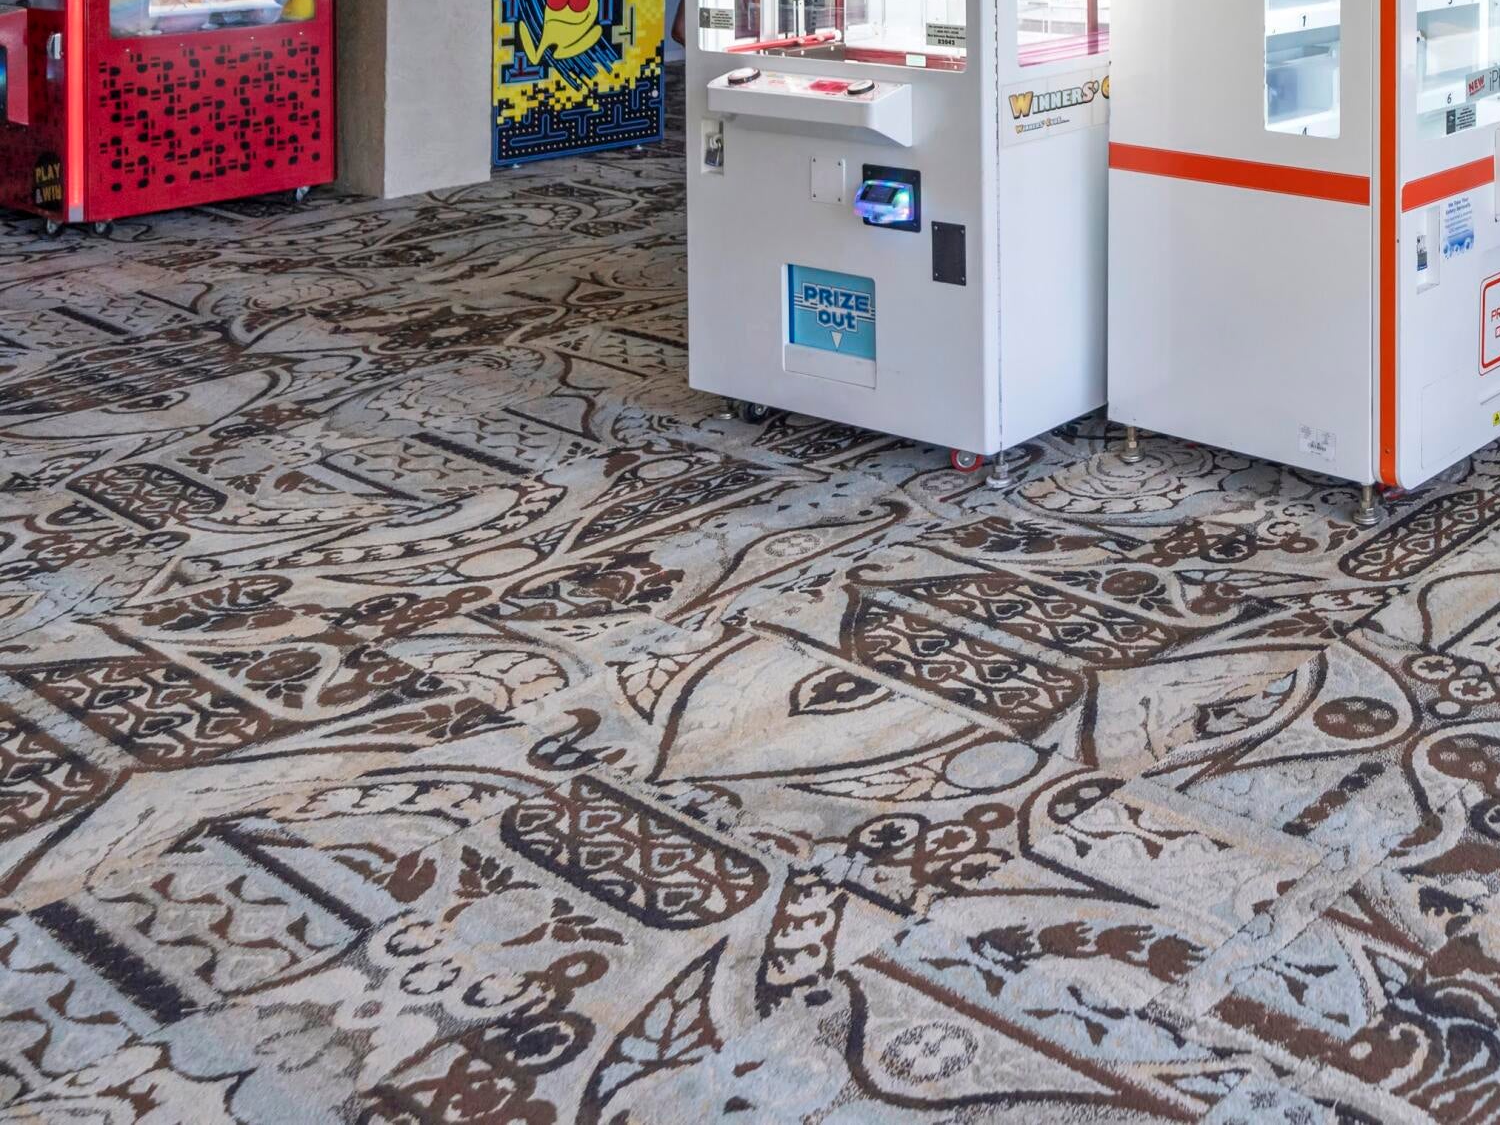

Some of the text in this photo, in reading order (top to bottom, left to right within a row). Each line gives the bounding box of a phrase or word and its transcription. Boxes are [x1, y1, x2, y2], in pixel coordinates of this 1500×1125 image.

[1468, 75, 1486, 93] NEW
[1446, 93, 1452, 105] 6
[34, 162, 61, 184] PLAY
[801, 283, 872, 315] PRIZE
